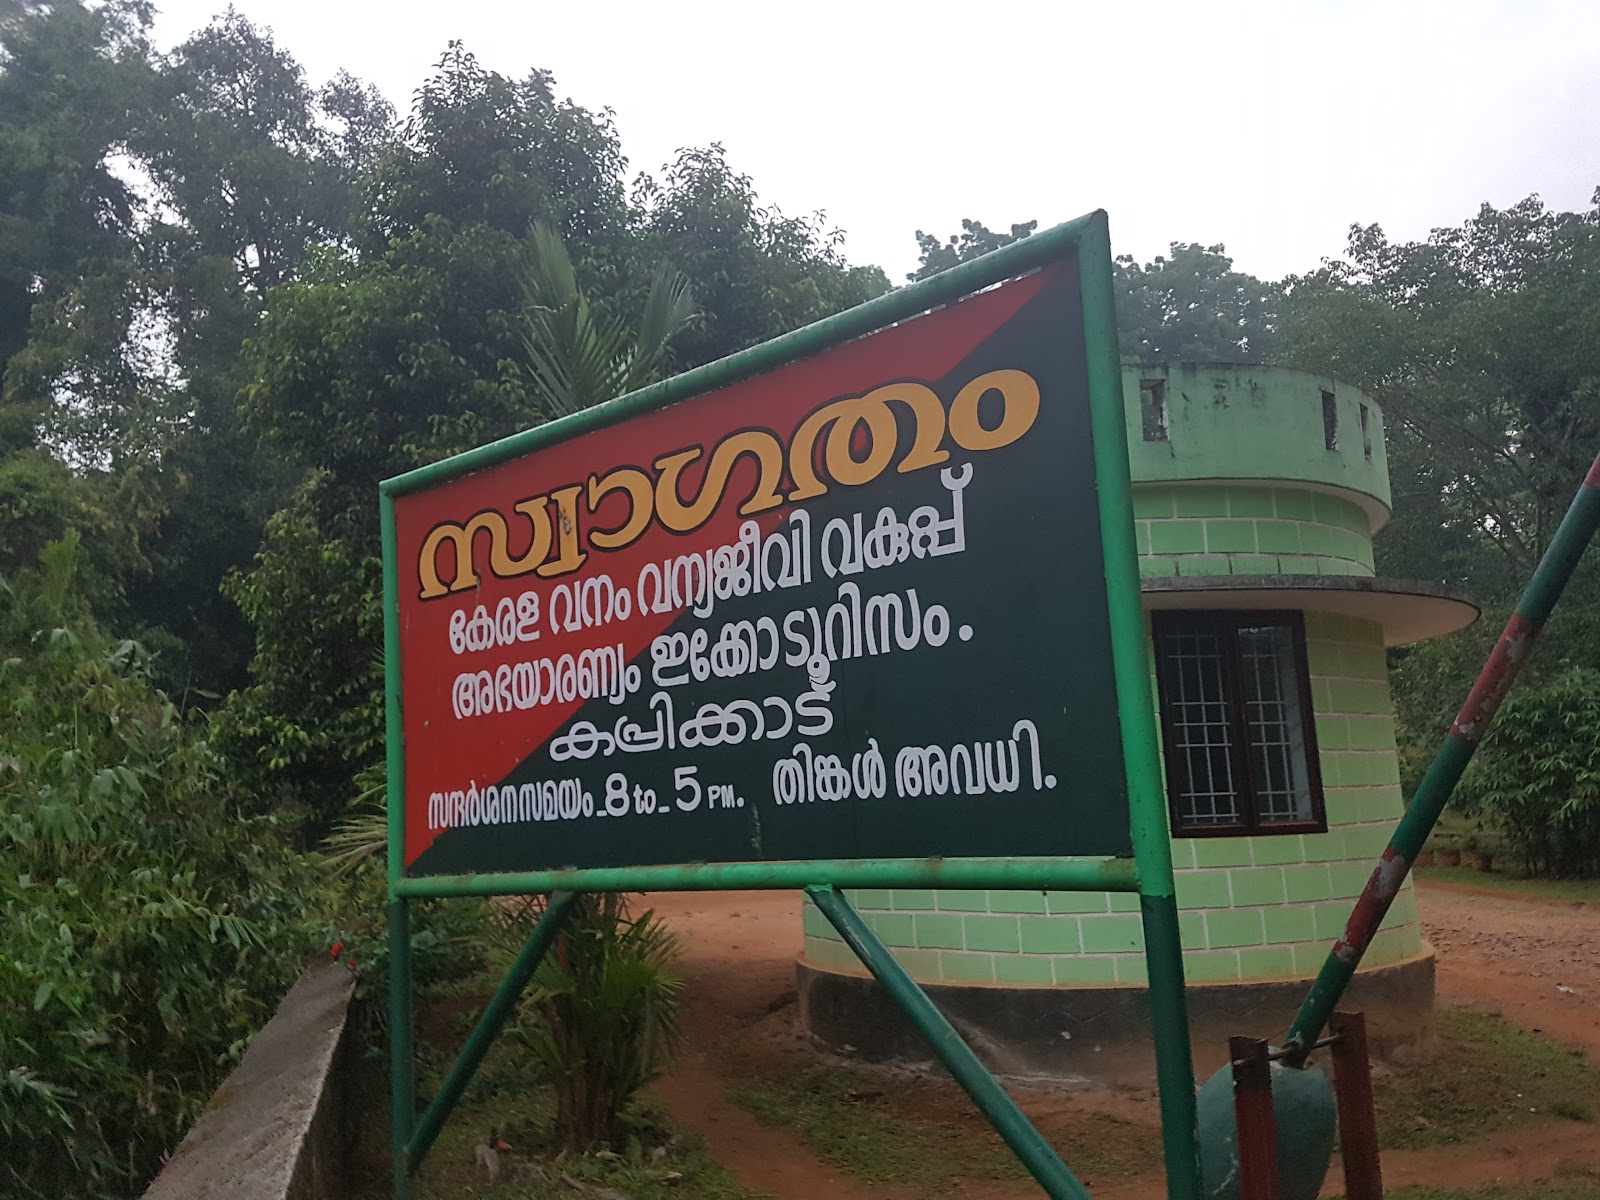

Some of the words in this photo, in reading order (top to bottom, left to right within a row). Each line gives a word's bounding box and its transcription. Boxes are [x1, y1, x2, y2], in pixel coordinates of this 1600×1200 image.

[420, 370, 1040, 599] സ്വാഗതം
[449, 591, 540, 655] കേരള
[549, 574, 632, 635] വനം
[637, 508, 812, 618] വന്യജീവി
[820, 462, 974, 579] വകുപ്പ്
[452, 642, 642, 720] അഭയാരണ്യം
[549, 679, 837, 761] കപ്രിക്കാട്
[772, 742, 887, 805] തിങ്കൾ
